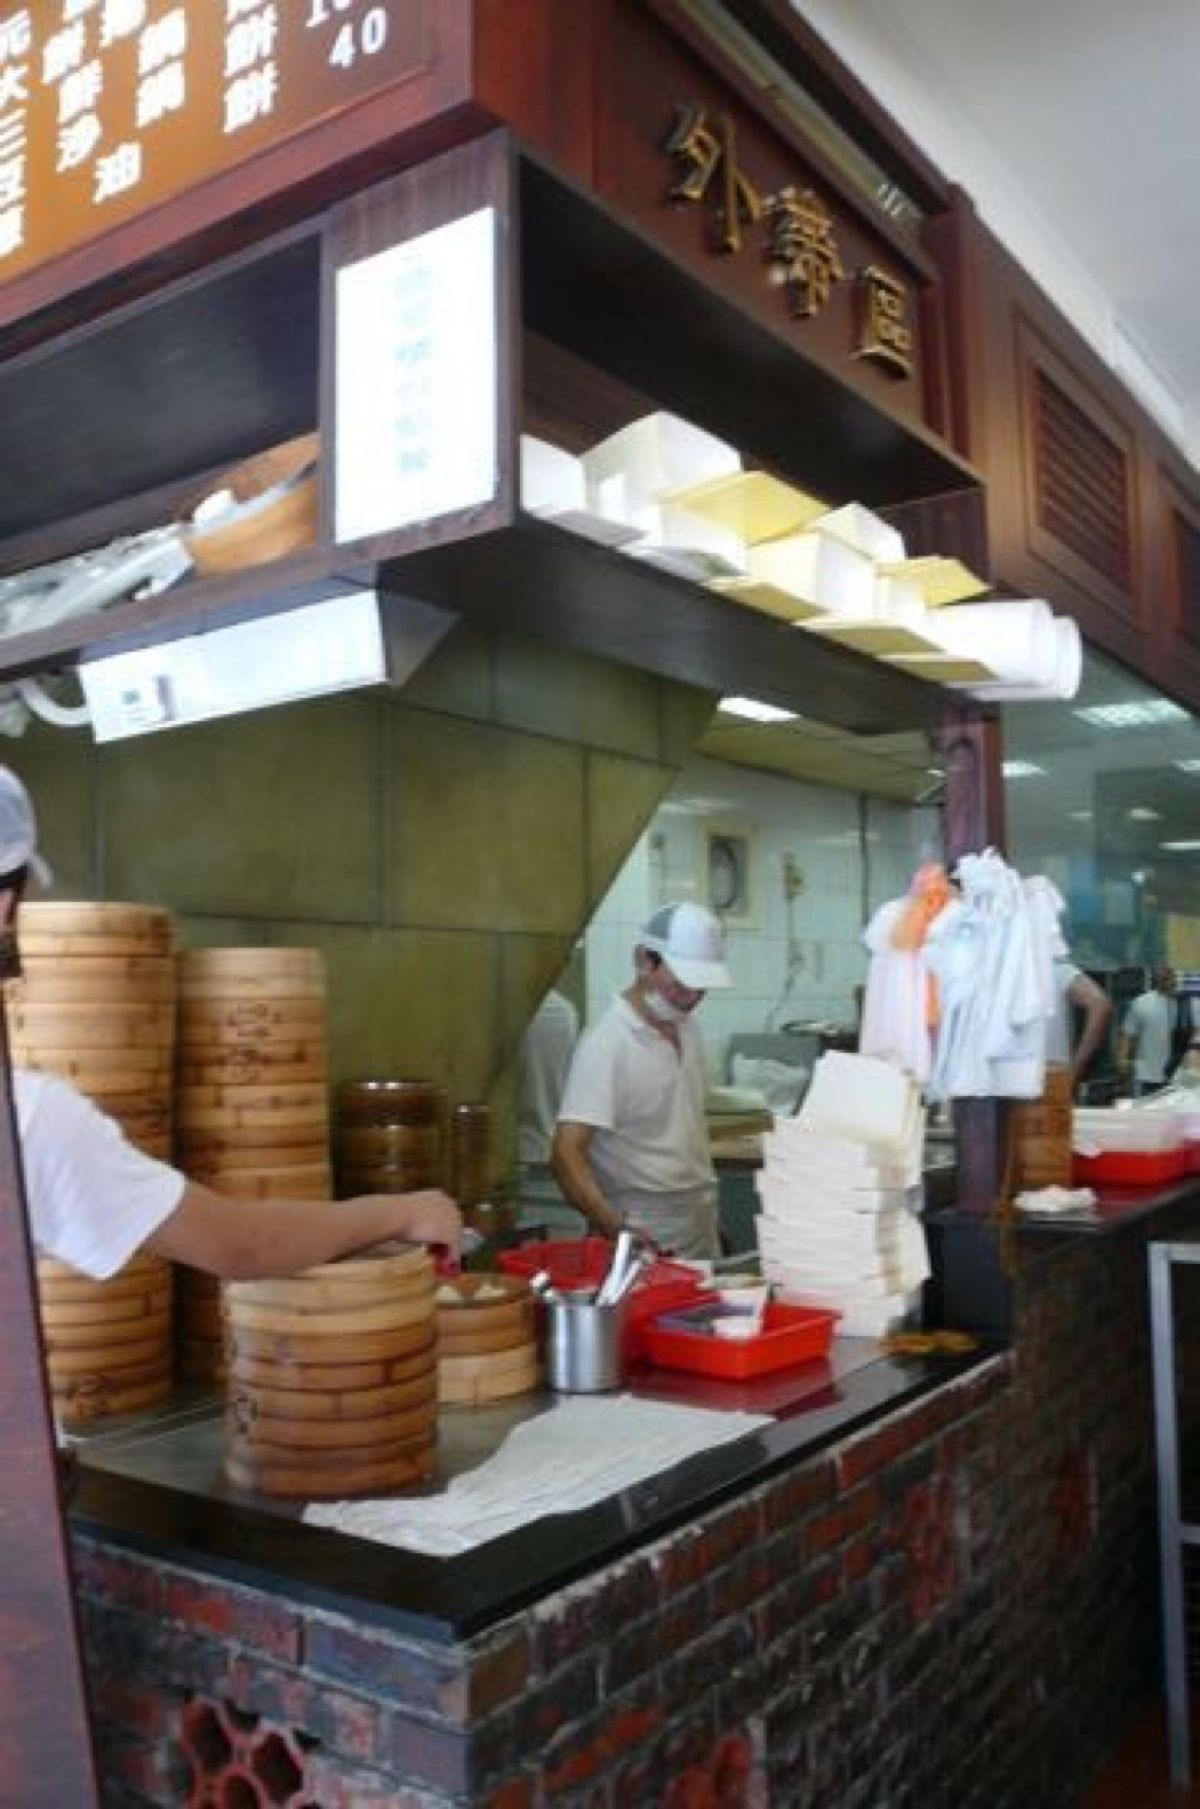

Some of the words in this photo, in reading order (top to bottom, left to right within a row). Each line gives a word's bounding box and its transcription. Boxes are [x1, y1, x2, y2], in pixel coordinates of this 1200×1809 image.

[328, 6, 387, 68] 40
[665, 104, 914, 381] 外帶區
